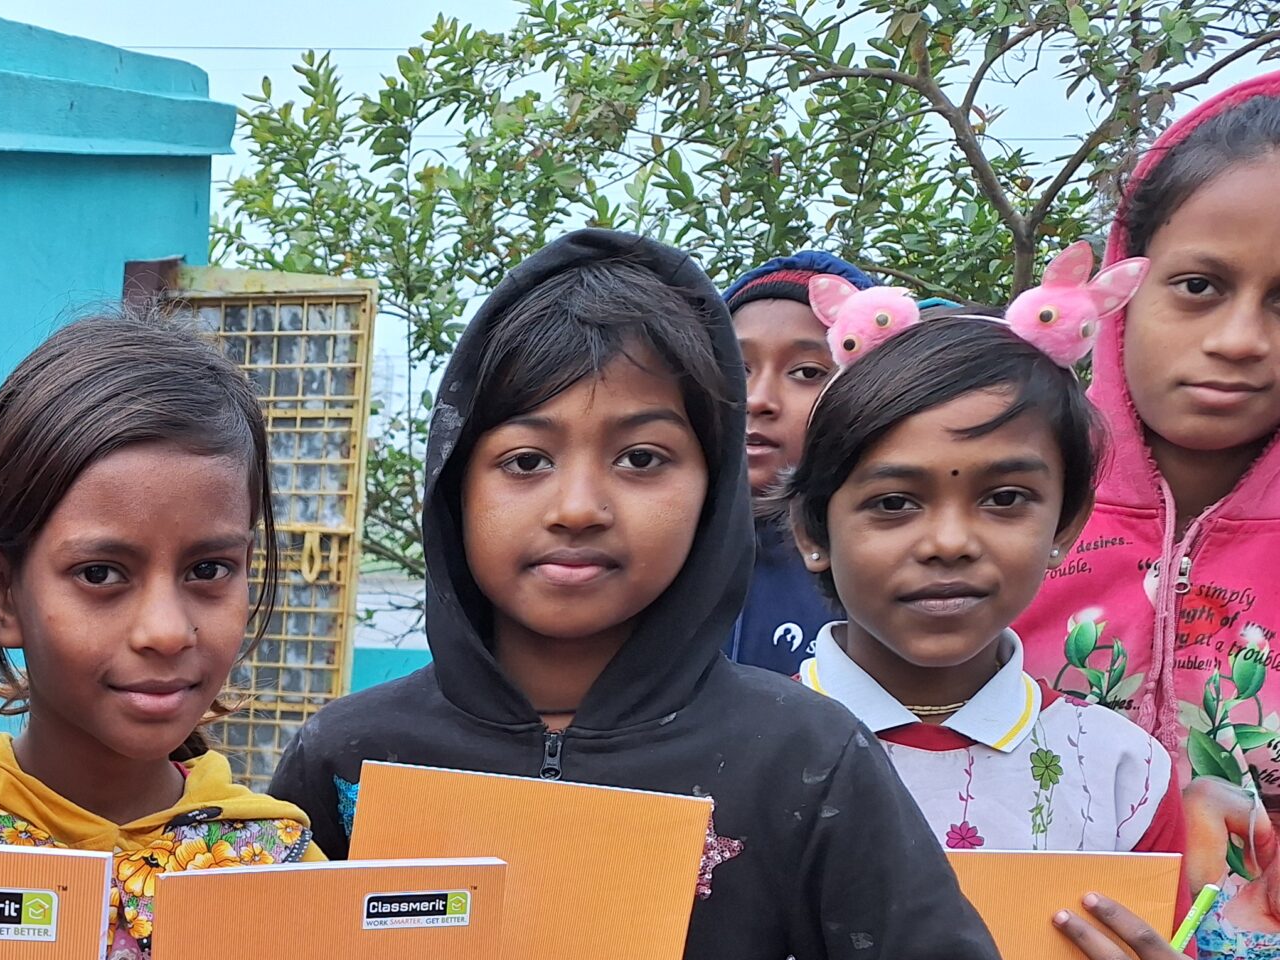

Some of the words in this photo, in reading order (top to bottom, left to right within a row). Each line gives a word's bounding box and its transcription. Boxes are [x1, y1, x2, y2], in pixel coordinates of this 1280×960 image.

[1046, 558, 1092, 579] rouble,
[1196, 581, 1256, 612] simply
[369, 899, 446, 913] Classmerit
[14, 927, 52, 937] BETTER.
